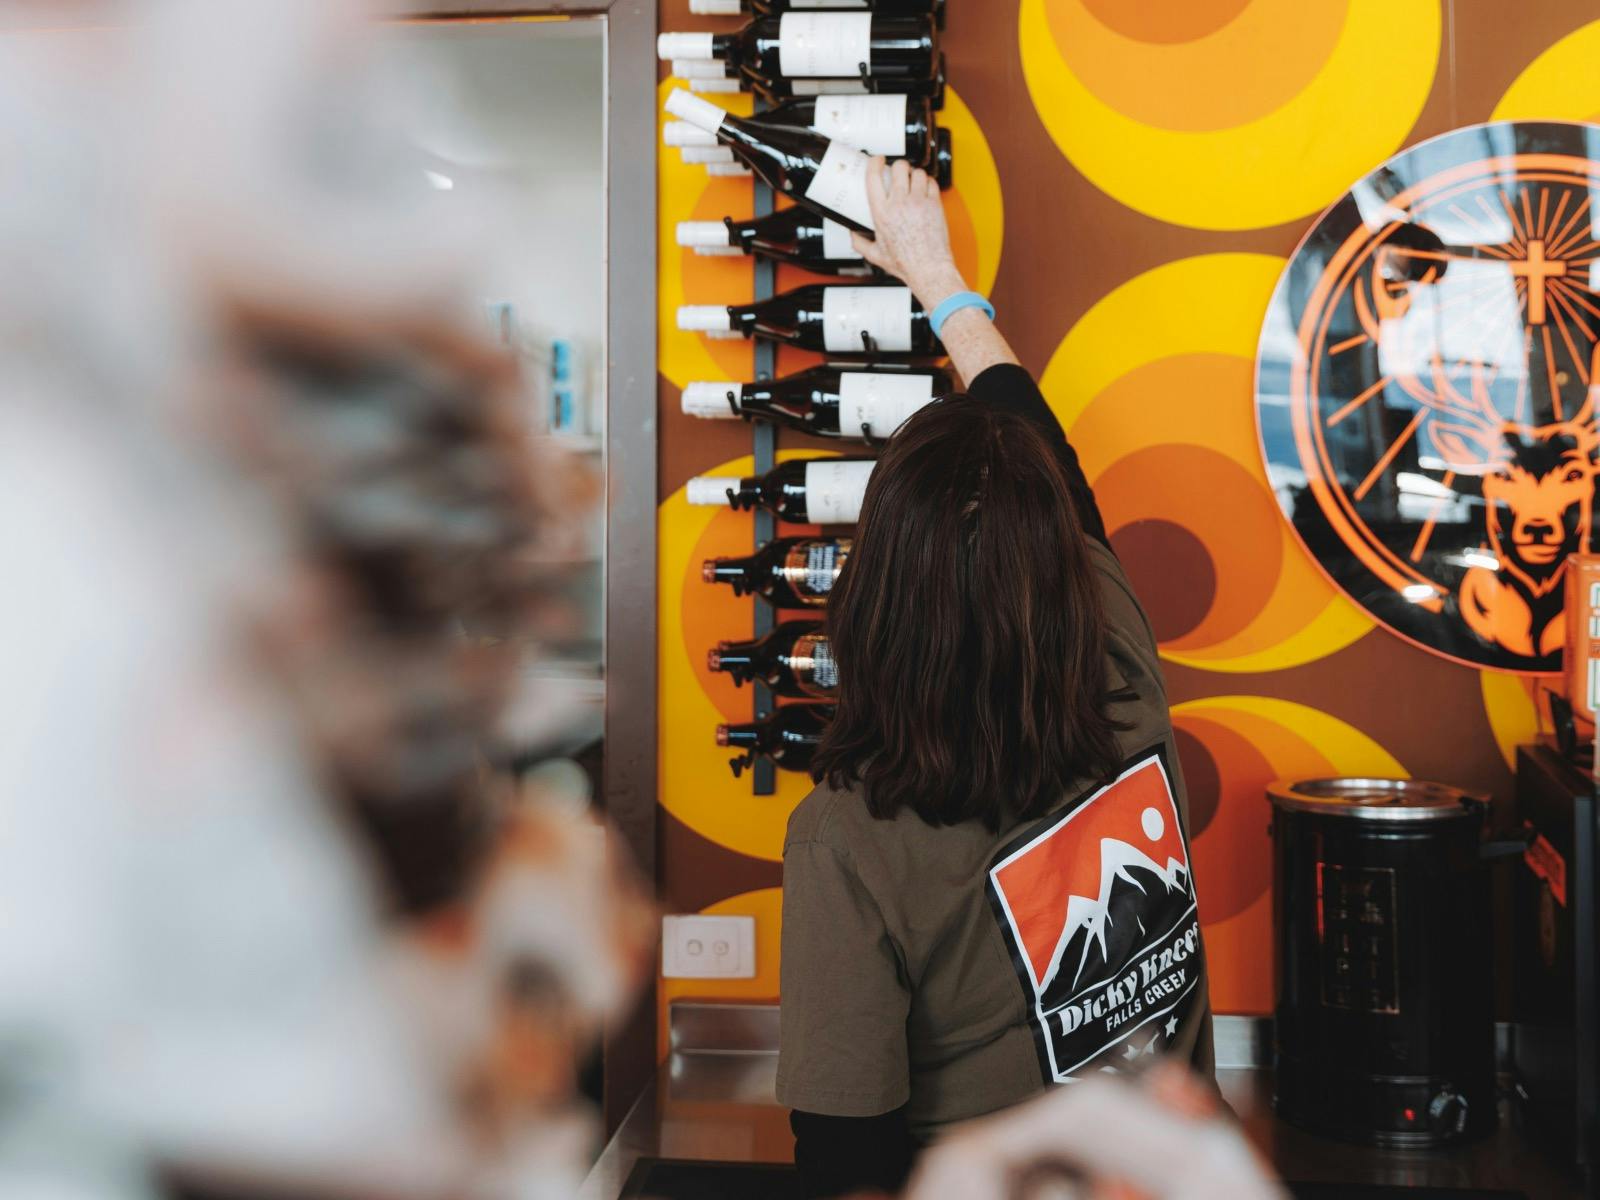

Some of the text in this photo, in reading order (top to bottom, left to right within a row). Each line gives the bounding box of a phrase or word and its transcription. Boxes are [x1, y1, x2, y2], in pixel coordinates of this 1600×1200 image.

[1057, 970, 1138, 1037] Dicky
[1105, 968, 1187, 1032] FALLS CREEK
